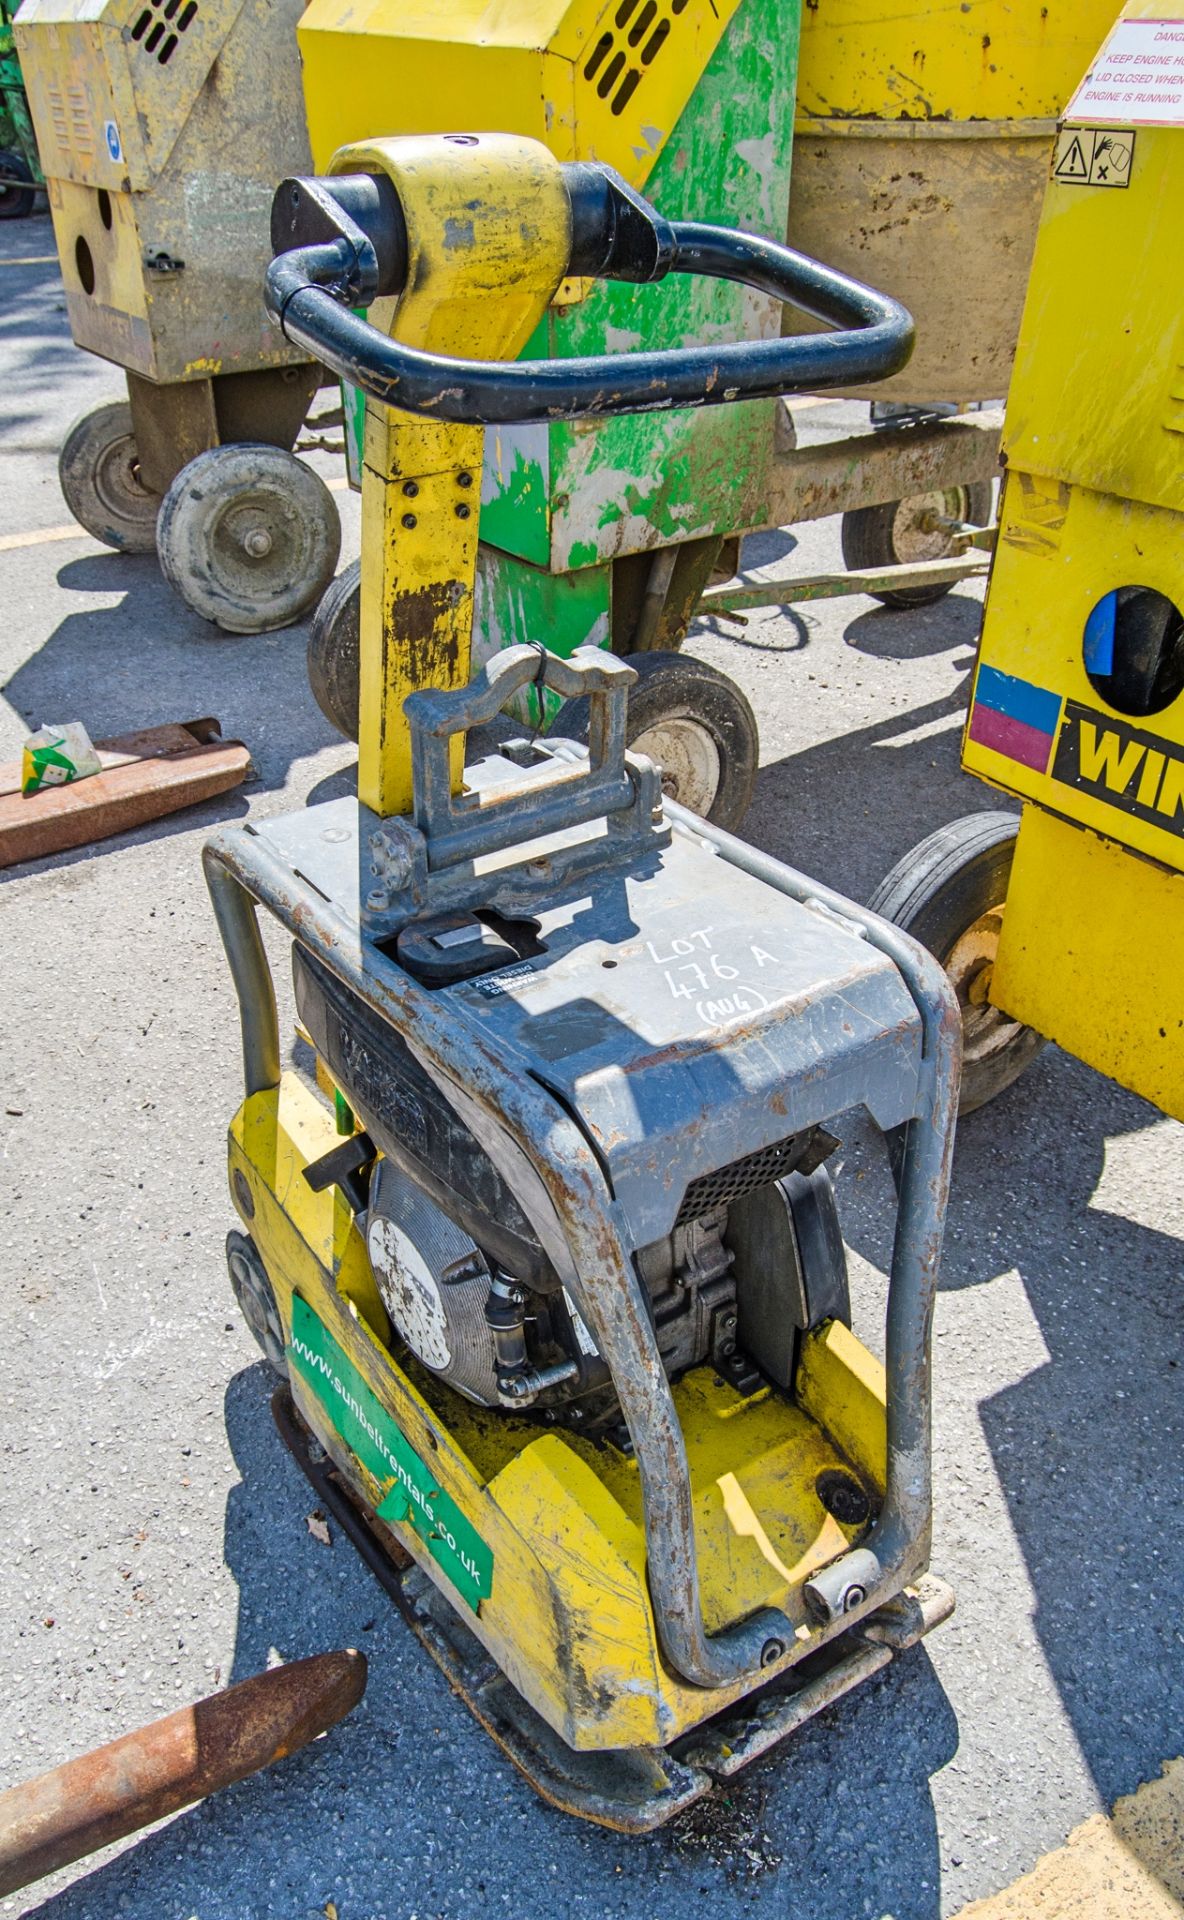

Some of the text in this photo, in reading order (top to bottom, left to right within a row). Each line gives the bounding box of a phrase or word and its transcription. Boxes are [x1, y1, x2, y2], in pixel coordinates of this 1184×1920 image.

[1153, 32, 1184, 42] DANG
[1106, 54, 1184, 66] KEEP ENGINE H
[1096, 73, 1112, 82] LID
[1113, 74, 1153, 83] CLOSED
[1084, 91, 1181, 104] ENGINE IS RUNNING
[646, 926, 714, 964] LOT
[475, 964, 533, 988] DIESEL ONLY
[664, 945, 780, 1000] 476 A
[490, 974, 539, 995] WARNING
[290, 1332, 481, 1587] www.sunbeltrentals.co.uk
